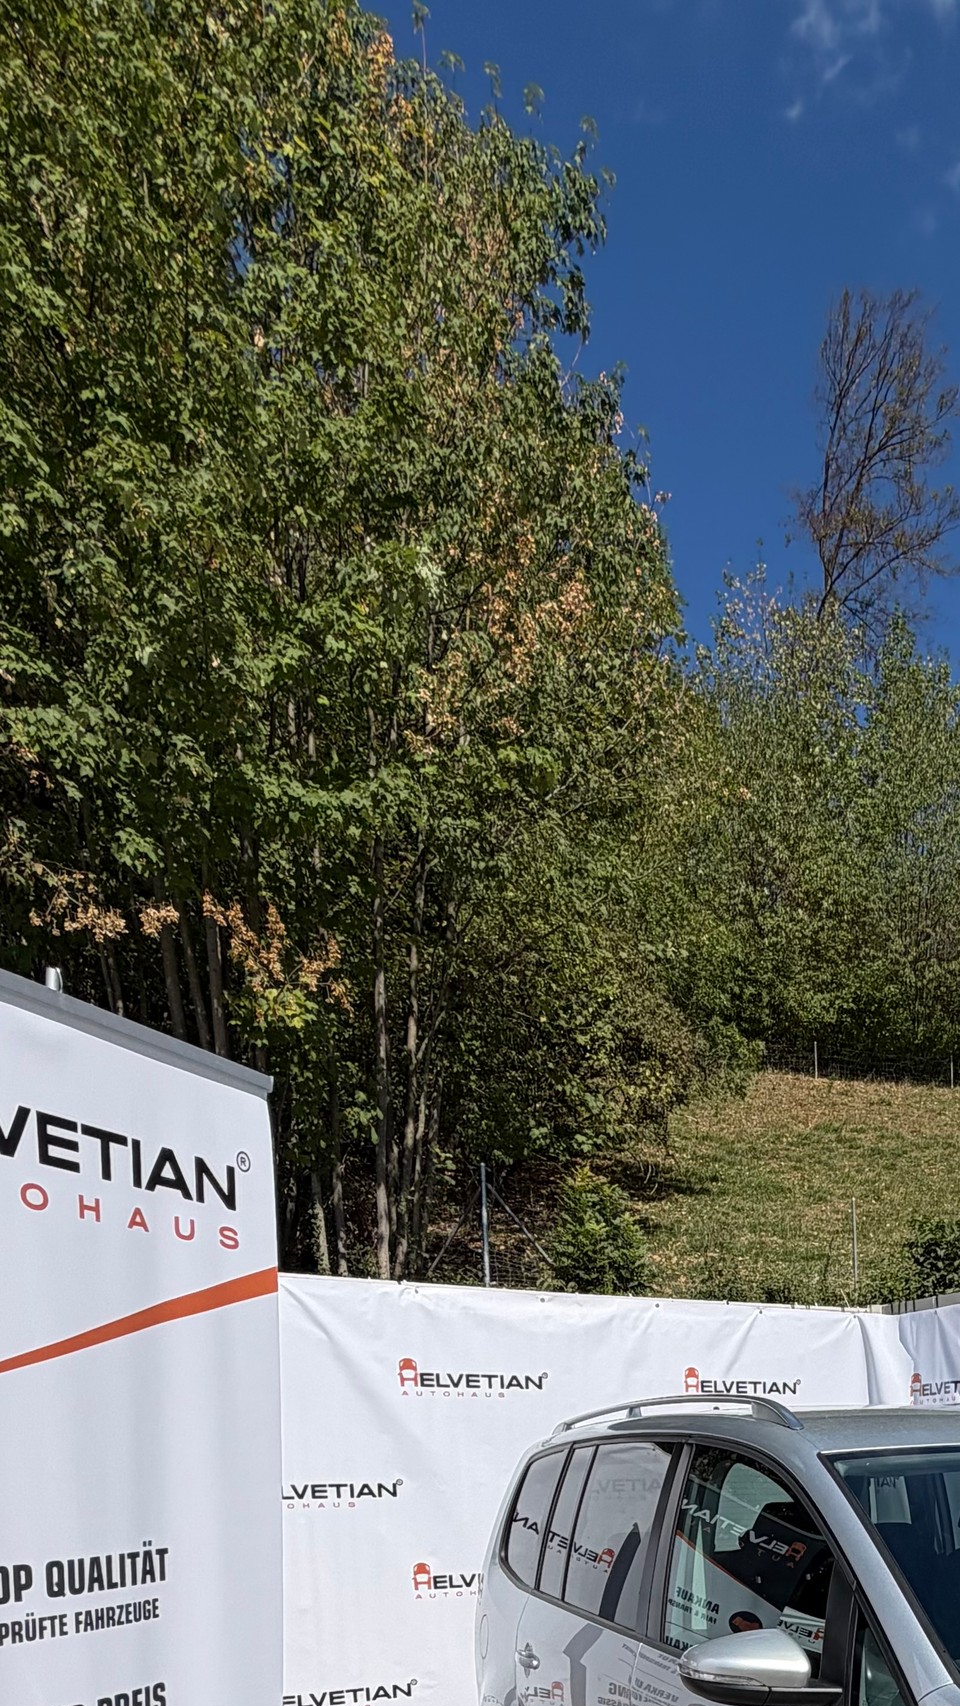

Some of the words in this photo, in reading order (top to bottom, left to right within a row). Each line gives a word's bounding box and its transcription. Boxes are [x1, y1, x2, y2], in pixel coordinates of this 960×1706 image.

[20, 1183, 240, 1250] OHAUS
[401, 1390, 506, 1398] AUTOHAUS
[287, 1501, 356, 1510] OHAUS
[45, 1541, 169, 1598] QUALITÄT
[74, 1598, 160, 1634] FAHRZEUGE
